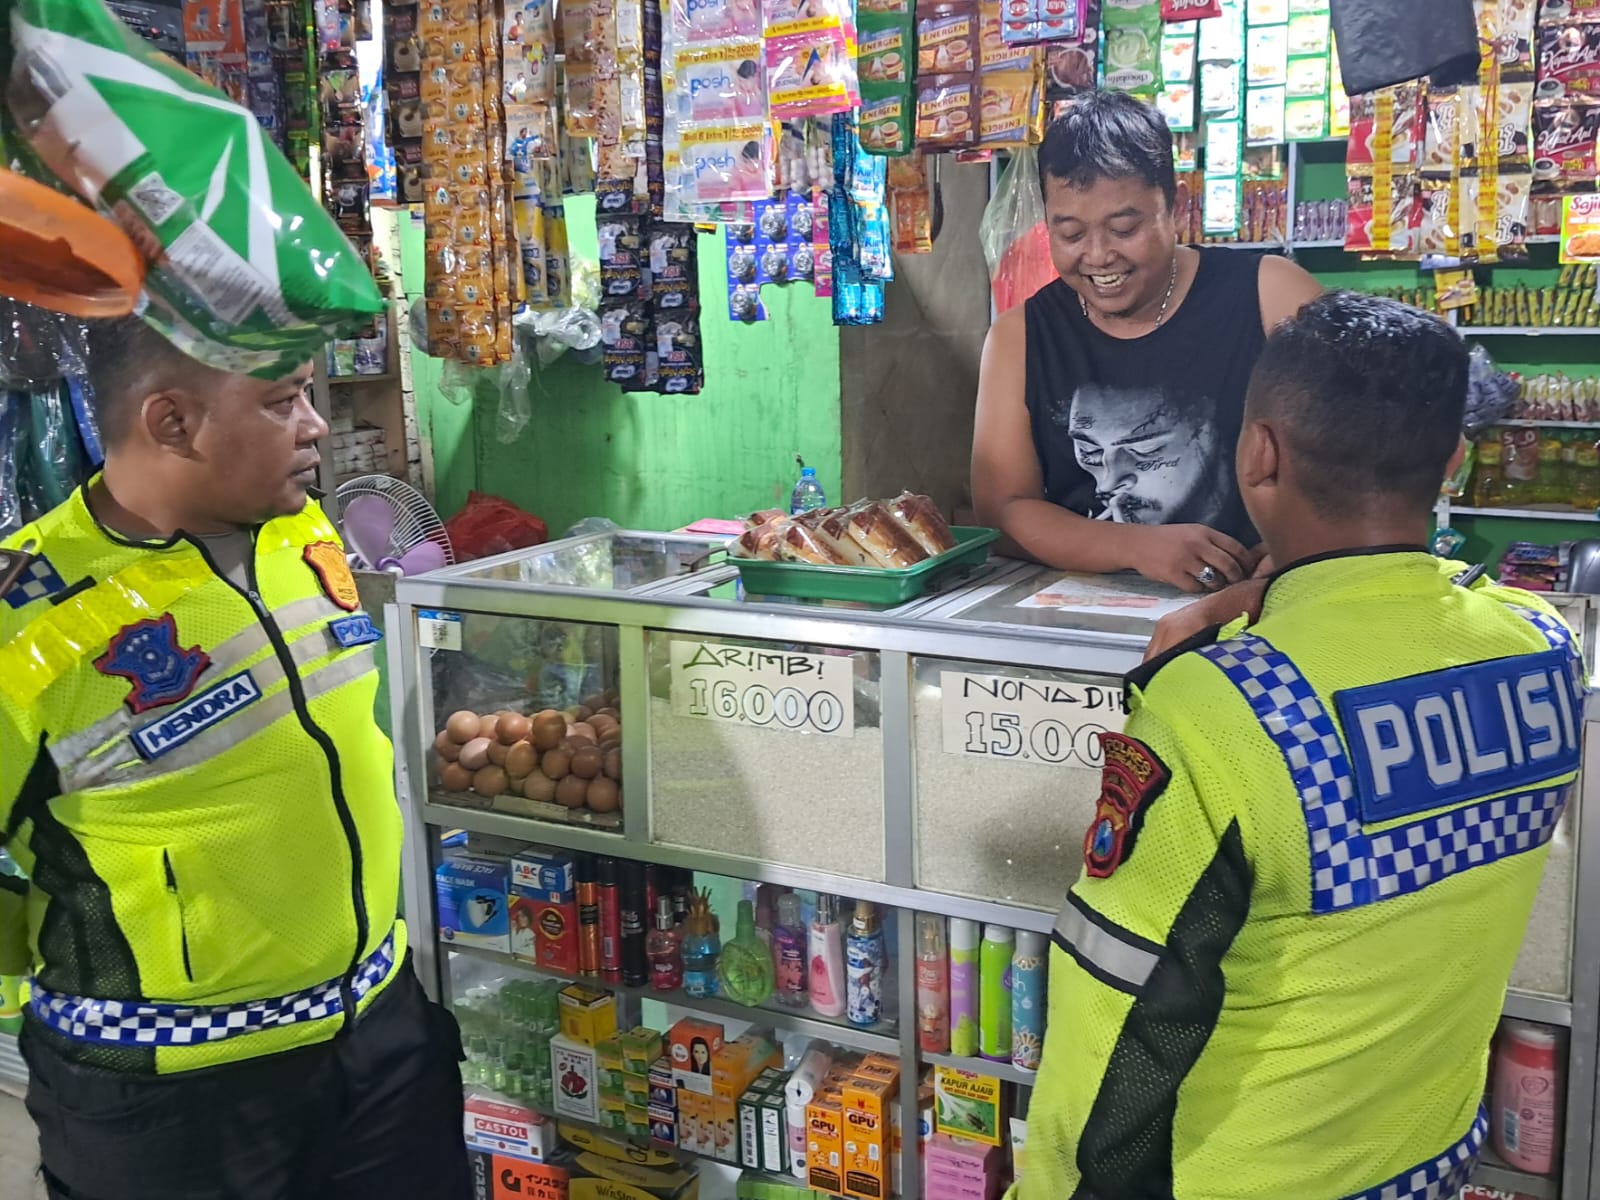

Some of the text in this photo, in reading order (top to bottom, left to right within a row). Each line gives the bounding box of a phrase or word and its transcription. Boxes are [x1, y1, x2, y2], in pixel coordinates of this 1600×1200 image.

[924, 23, 967, 42] ENERGEN
[861, 36, 900, 53] ENERGEN
[691, 70, 730, 95] posh
[862, 105, 898, 121] ENERGEN
[336, 619, 374, 642] POL
[146, 682, 251, 748] HENDRA
[689, 678, 844, 734] 16.000
[1357, 668, 1577, 798] POLISI
[515, 864, 537, 877] ABC
[941, 1077, 994, 1097] KAPUR AJAIB
[475, 1119, 527, 1139] CASTOL
[811, 1118, 837, 1133] GPU
[848, 1113, 876, 1129] GPU
